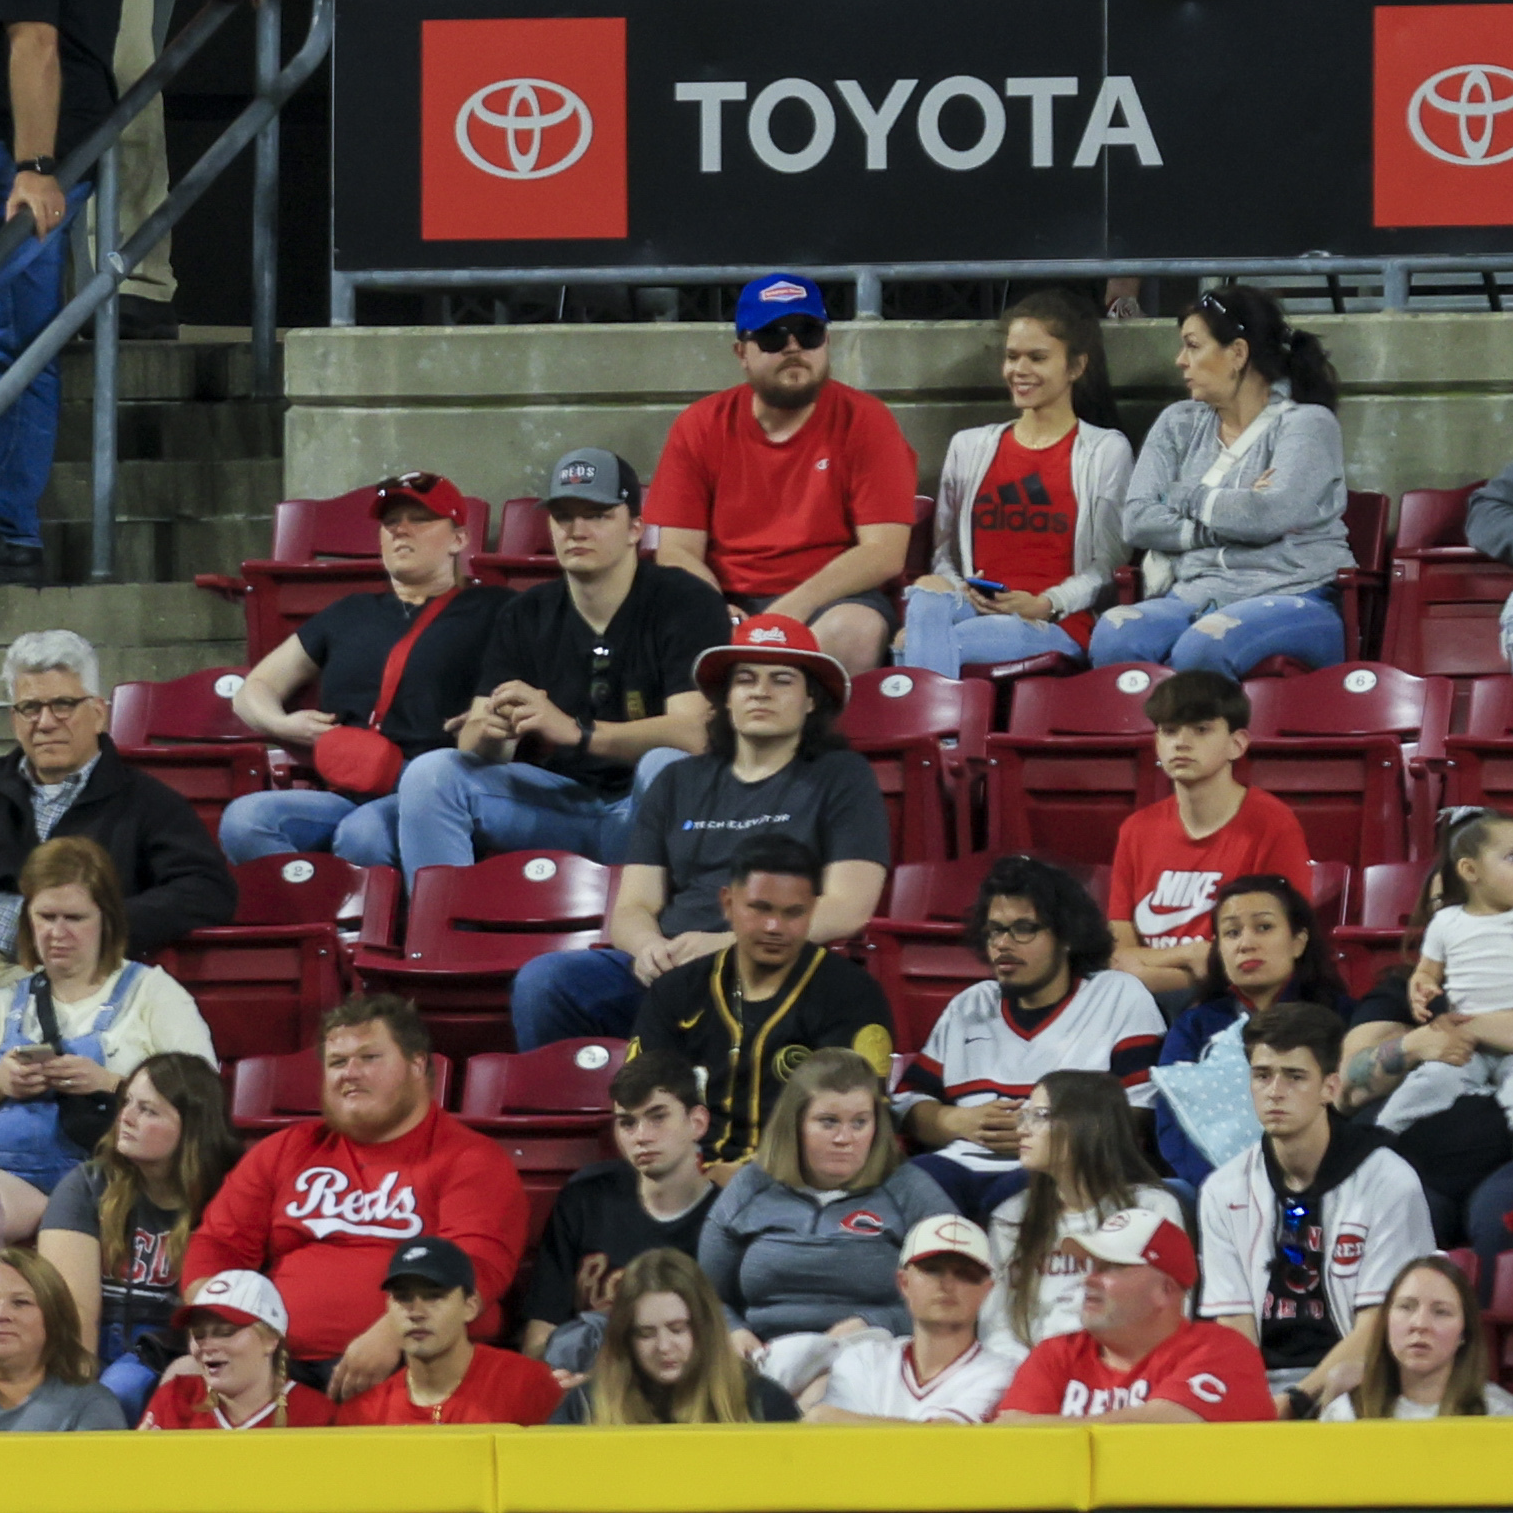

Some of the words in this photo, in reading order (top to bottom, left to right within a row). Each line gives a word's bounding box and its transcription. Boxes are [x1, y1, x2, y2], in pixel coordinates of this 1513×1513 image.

[674, 75, 1164, 174] TOYOTA
[560, 465, 595, 480] REDS
[975, 503, 1069, 535] didas
[1150, 870, 1224, 908] NIKE
[286, 1166, 422, 1239] Reds
[1060, 1378, 1149, 1418] REDS
